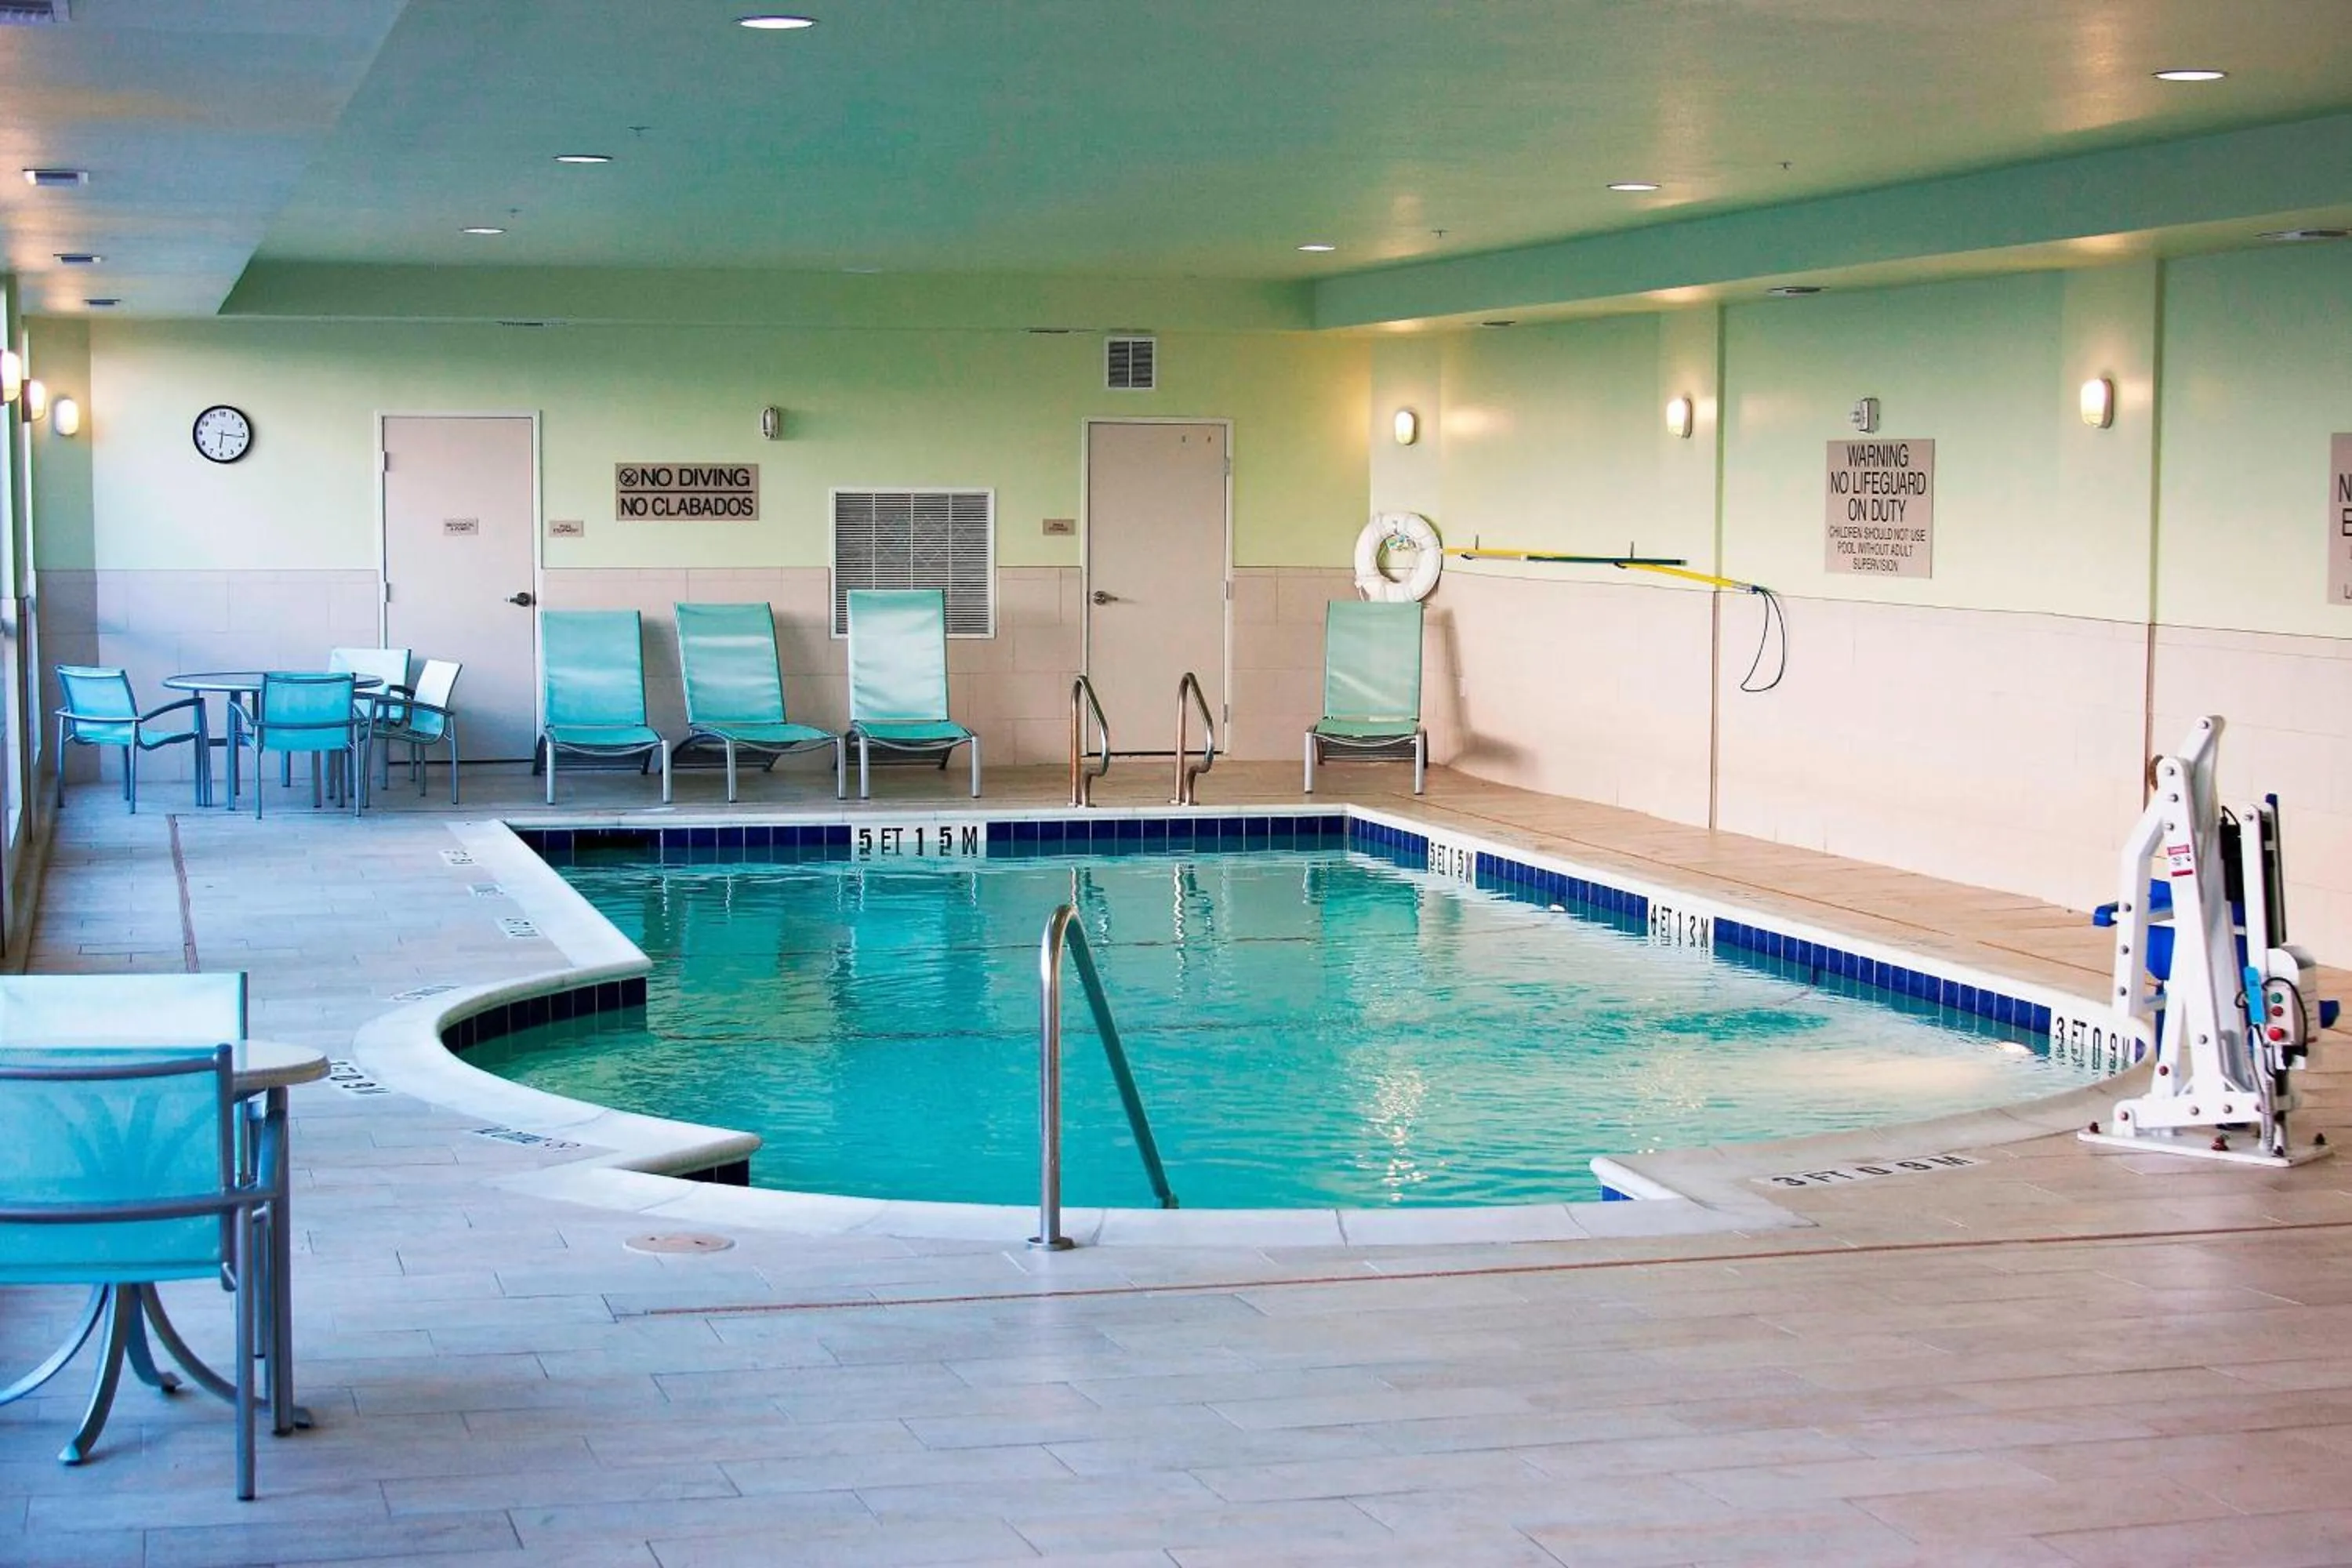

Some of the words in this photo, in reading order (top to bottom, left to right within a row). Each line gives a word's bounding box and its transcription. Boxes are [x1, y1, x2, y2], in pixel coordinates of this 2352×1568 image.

[1846, 444, 1908, 468] WARNING
[641, 468, 673, 486] NO
[679, 468, 750, 486] DIVING
[1831, 471, 1849, 494] NO
[1853, 471, 1926, 495] LIFEGUARD
[620, 497, 648, 516] NO
[652, 496, 753, 517] CLABADOS
[1848, 498, 1866, 521] ON
[1871, 499, 1907, 522] DUTY
[1829, 525, 1862, 539] CHILDREN
[1864, 526, 1892, 540] SHOULD
[1893, 528, 1908, 541] NOT
[1911, 528, 1926, 542] USE
[1837, 541, 1856, 554] POOL
[1858, 543, 1889, 556] WITHOUT
[1891, 543, 1913, 557] ADULT
[1853, 557, 1898, 572] SUPERVISION
[858, 827, 872, 855] 5
[880, 827, 903, 855] FT
[939, 826, 953, 856] 5
[961, 826, 978, 856] M
